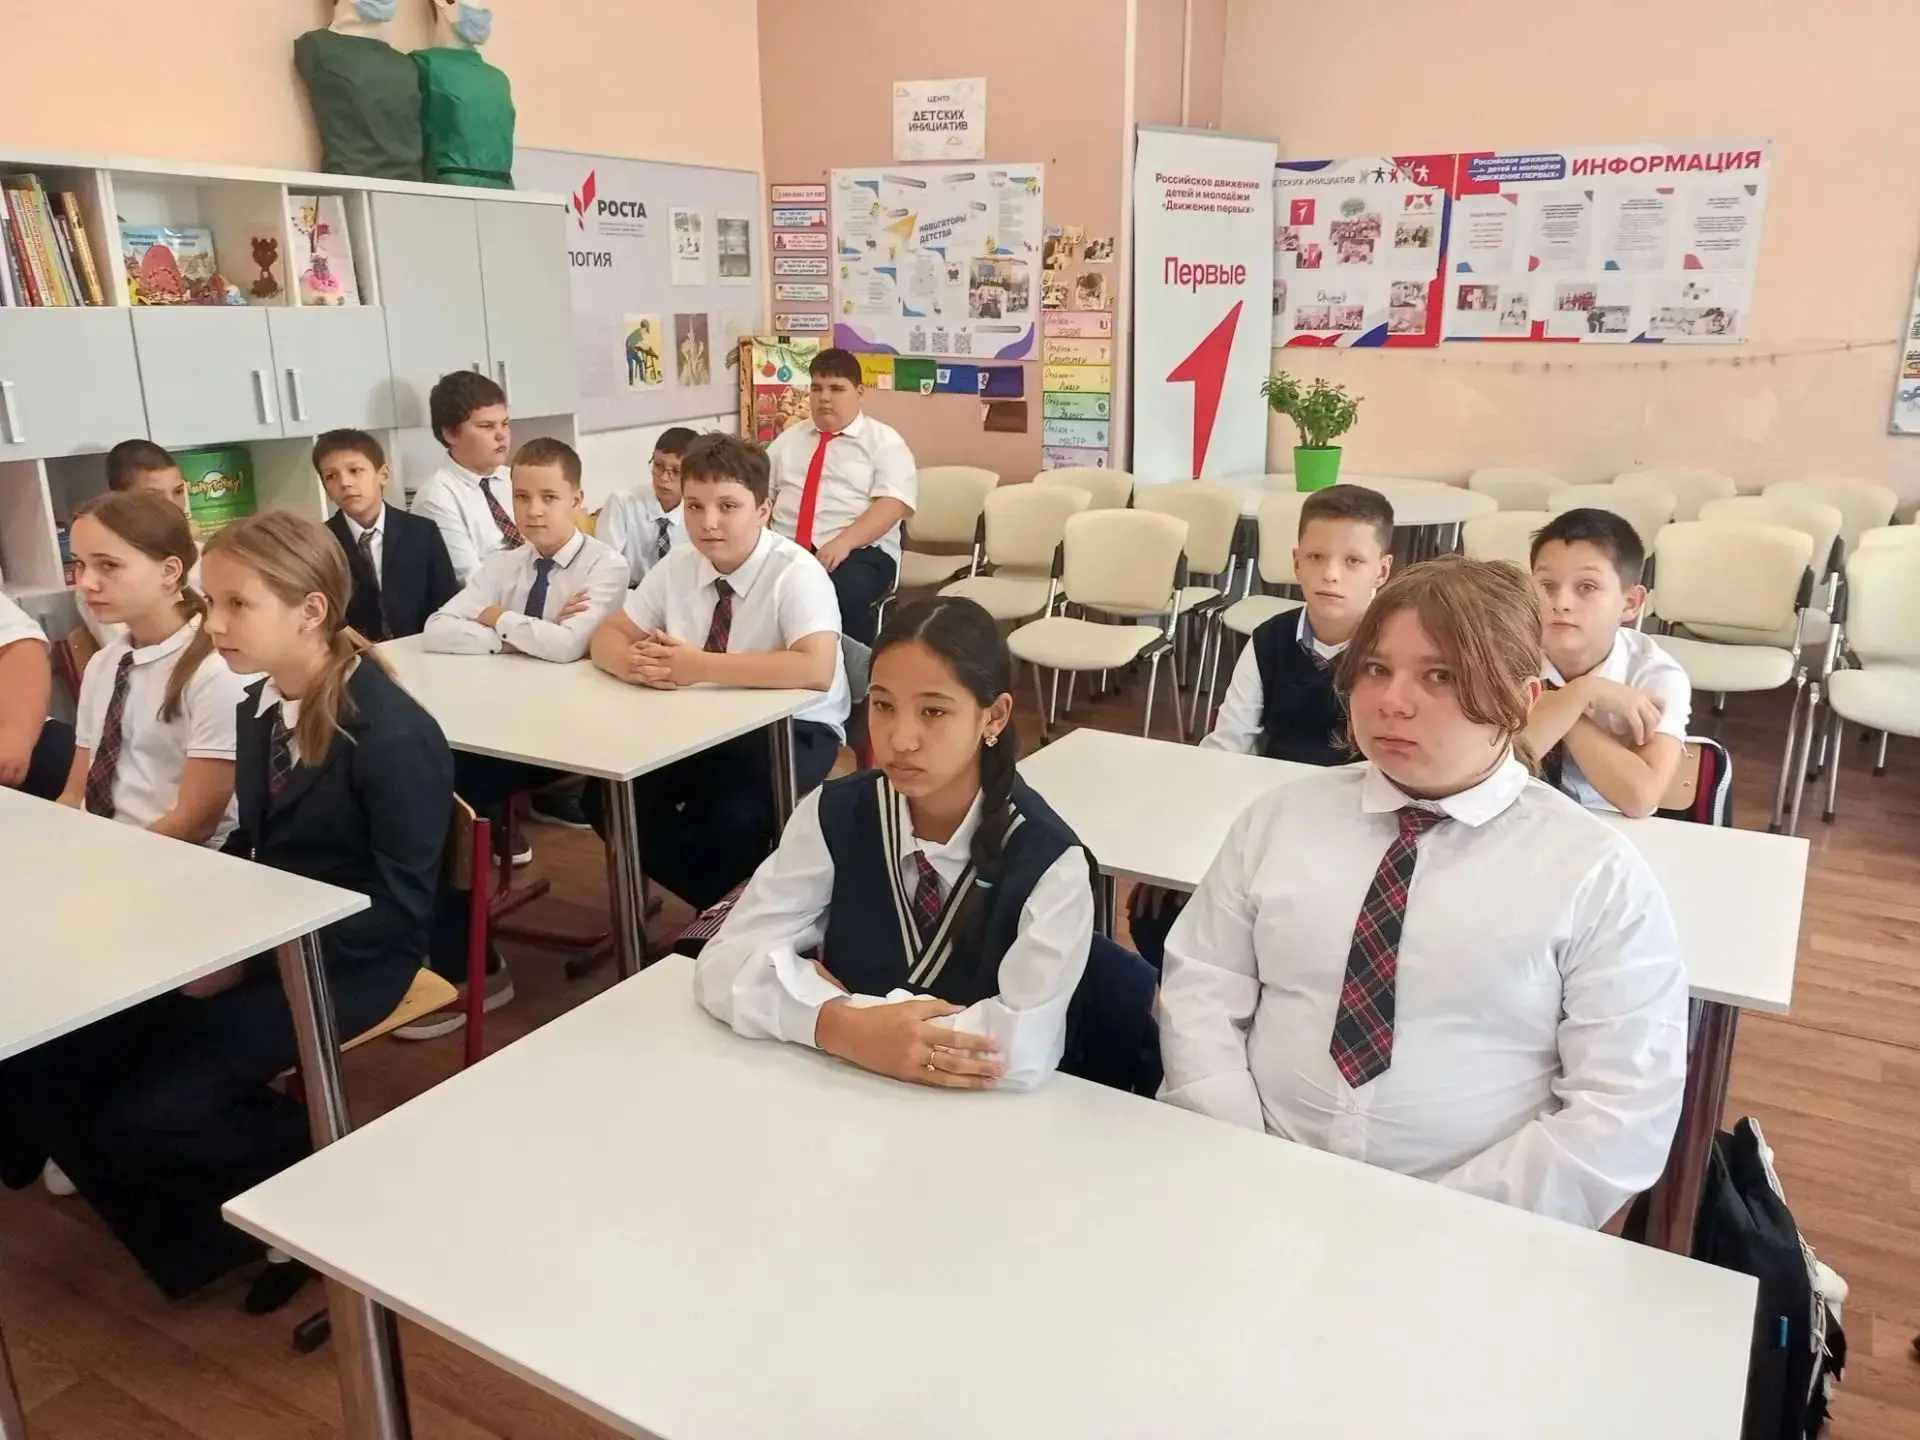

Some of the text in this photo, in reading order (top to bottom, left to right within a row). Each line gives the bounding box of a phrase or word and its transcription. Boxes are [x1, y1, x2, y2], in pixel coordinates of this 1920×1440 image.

[927, 95, 950, 103] ЦЕНТР
[912, 109, 964, 122] ДЕТСКИХ
[907, 121, 968, 132] ИНИЦИАТИВ
[1572, 151, 1761, 176] ИНФОРМАЦИЯ
[1155, 173, 1260, 189] Российское движение
[1304, 176, 1355, 185] ИНИЦИАТИВ
[1165, 188, 1194, 198] детей
[1195, 190, 1201, 198] и
[597, 199, 647, 218] РОСТА
[919, 214, 967, 232] НАВИГАТОРЫ
[919, 228, 952, 245] ДЕТСТВА
[1164, 257, 1246, 293] Первые
